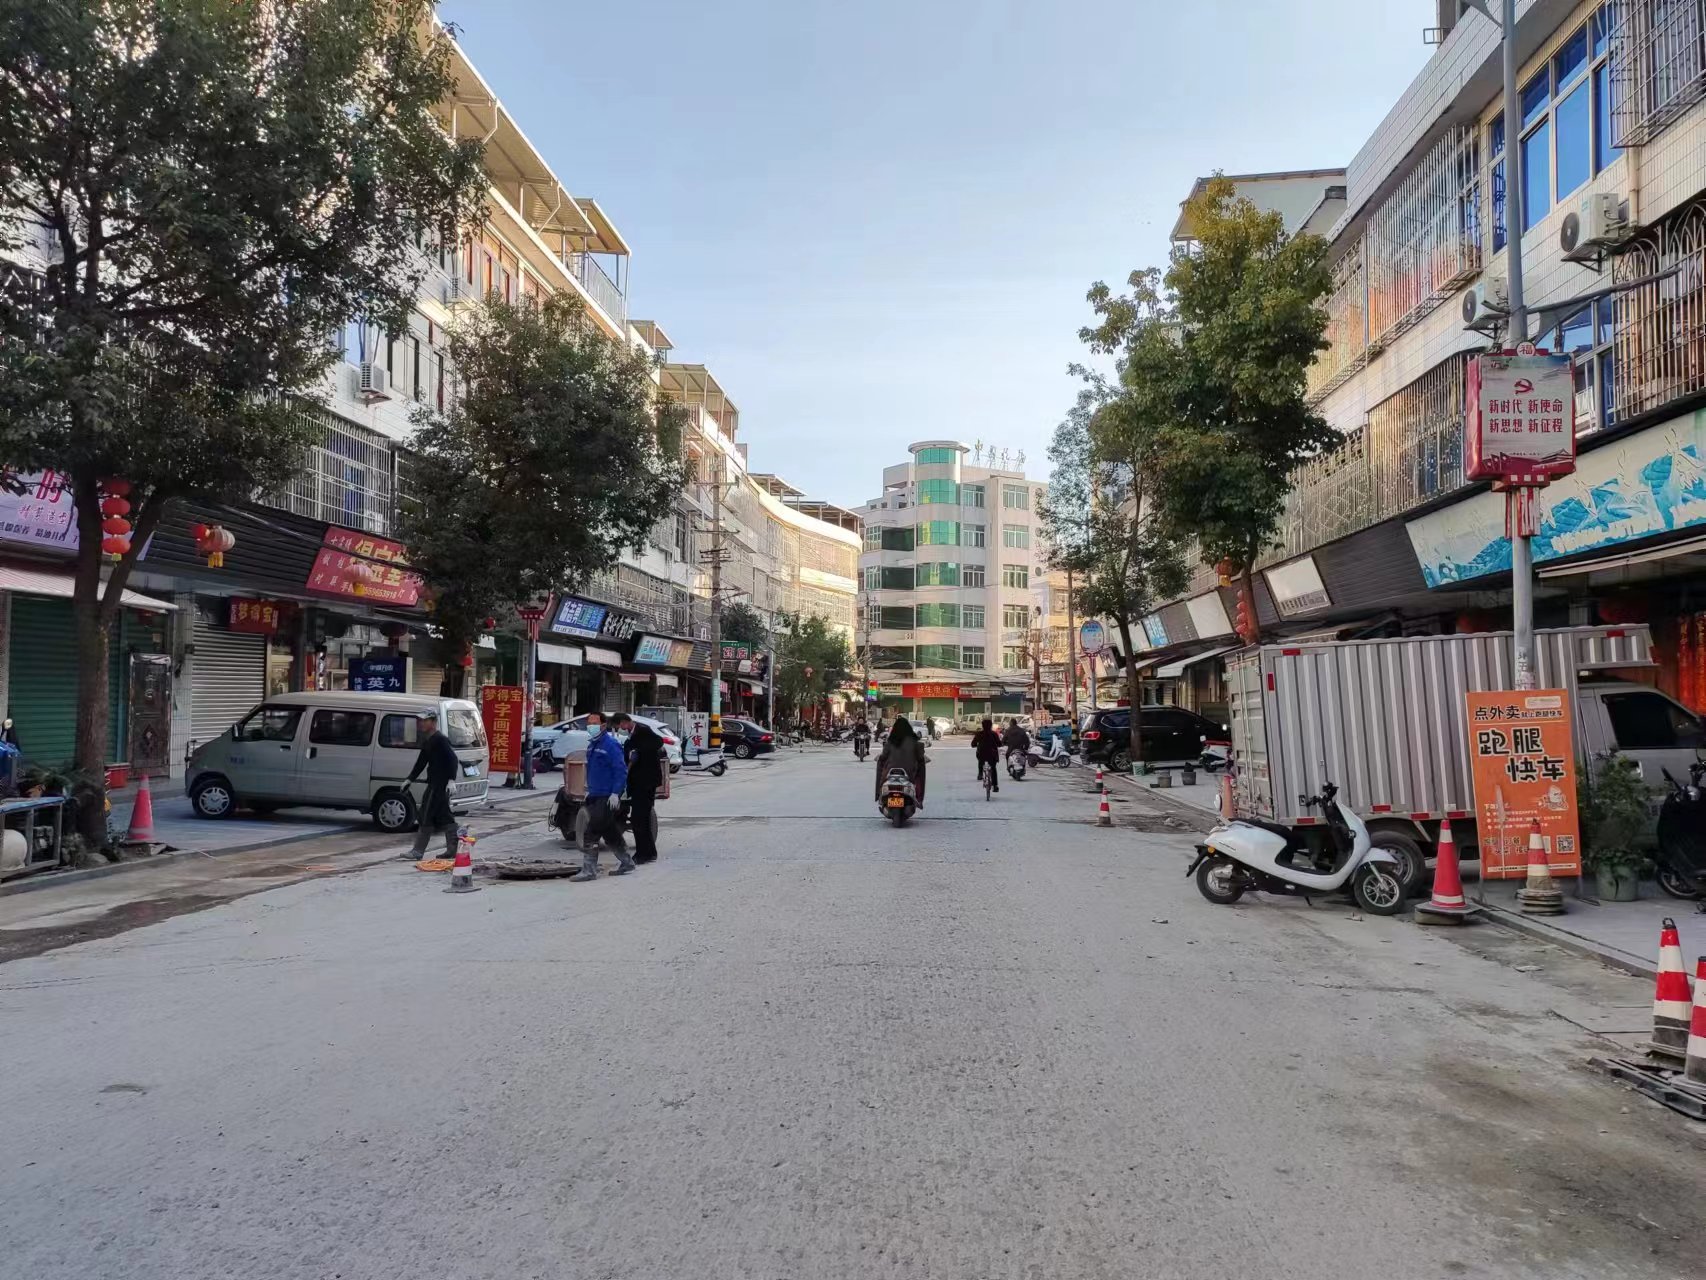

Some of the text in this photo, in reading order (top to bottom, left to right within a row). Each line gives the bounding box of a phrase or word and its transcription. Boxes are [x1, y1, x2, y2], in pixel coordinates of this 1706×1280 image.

[1519, 344, 1533, 355] 福
[1489, 398, 1563, 414] 新时代 新使命
[1489, 418, 1563, 433] 新思想 新征程
[484, 688, 523, 702] 梦得宝
[1474, 705, 1520, 720] 点外卖
[491, 702, 513, 764] 字画装框
[1478, 727, 1543, 755] 跑腿
[1506, 756, 1565, 782] 快车
